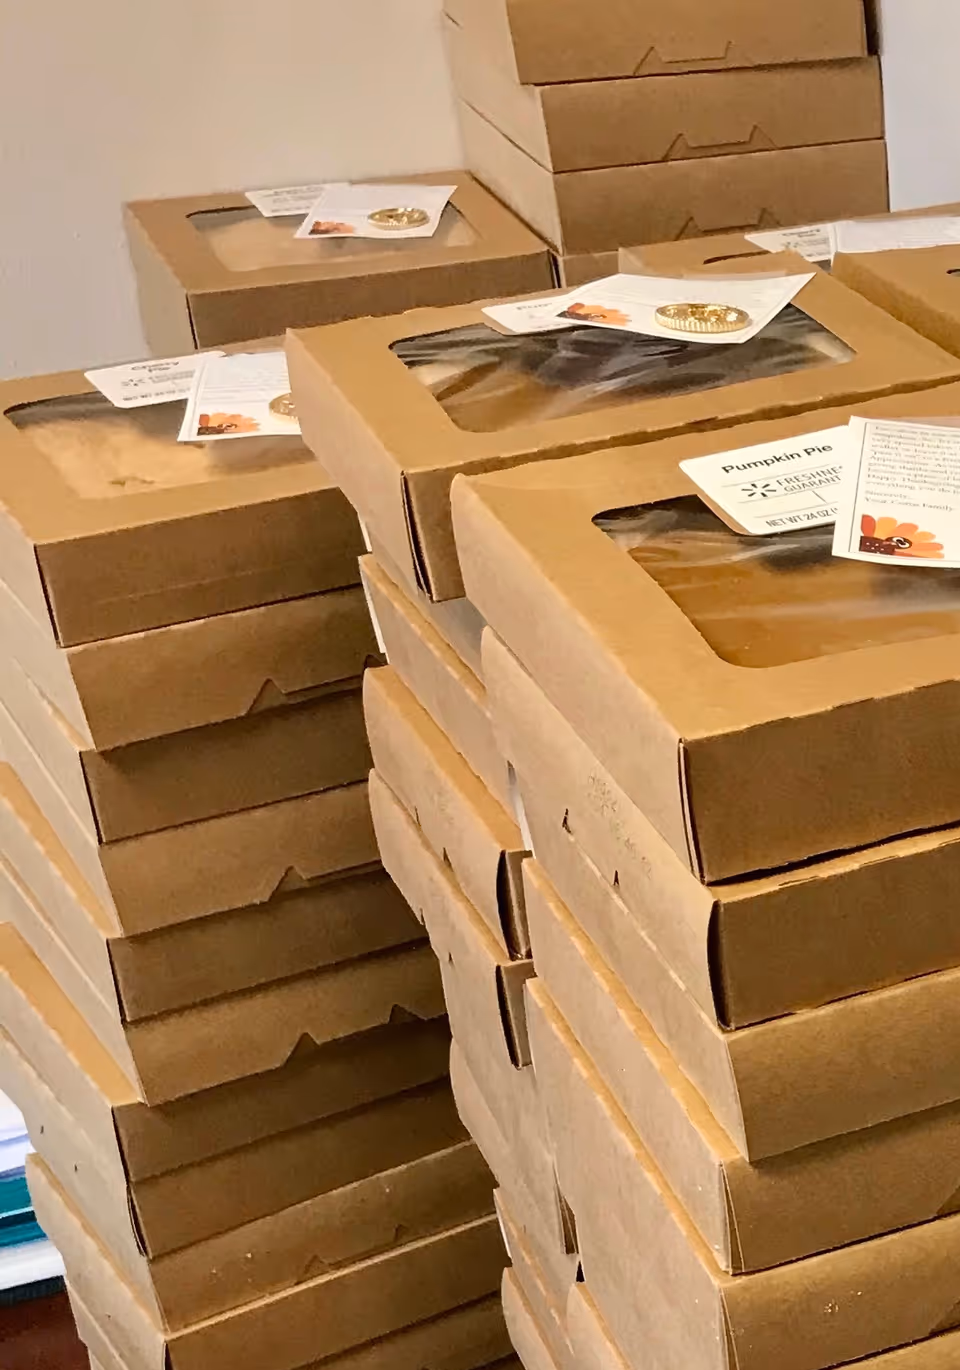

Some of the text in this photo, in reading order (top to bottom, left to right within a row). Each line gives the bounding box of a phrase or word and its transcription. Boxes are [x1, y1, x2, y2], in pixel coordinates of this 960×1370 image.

[722, 445, 833, 474] Pumpkin Pie
[776, 465, 843, 486] FRESHNE
[766, 518, 787, 528] NET
